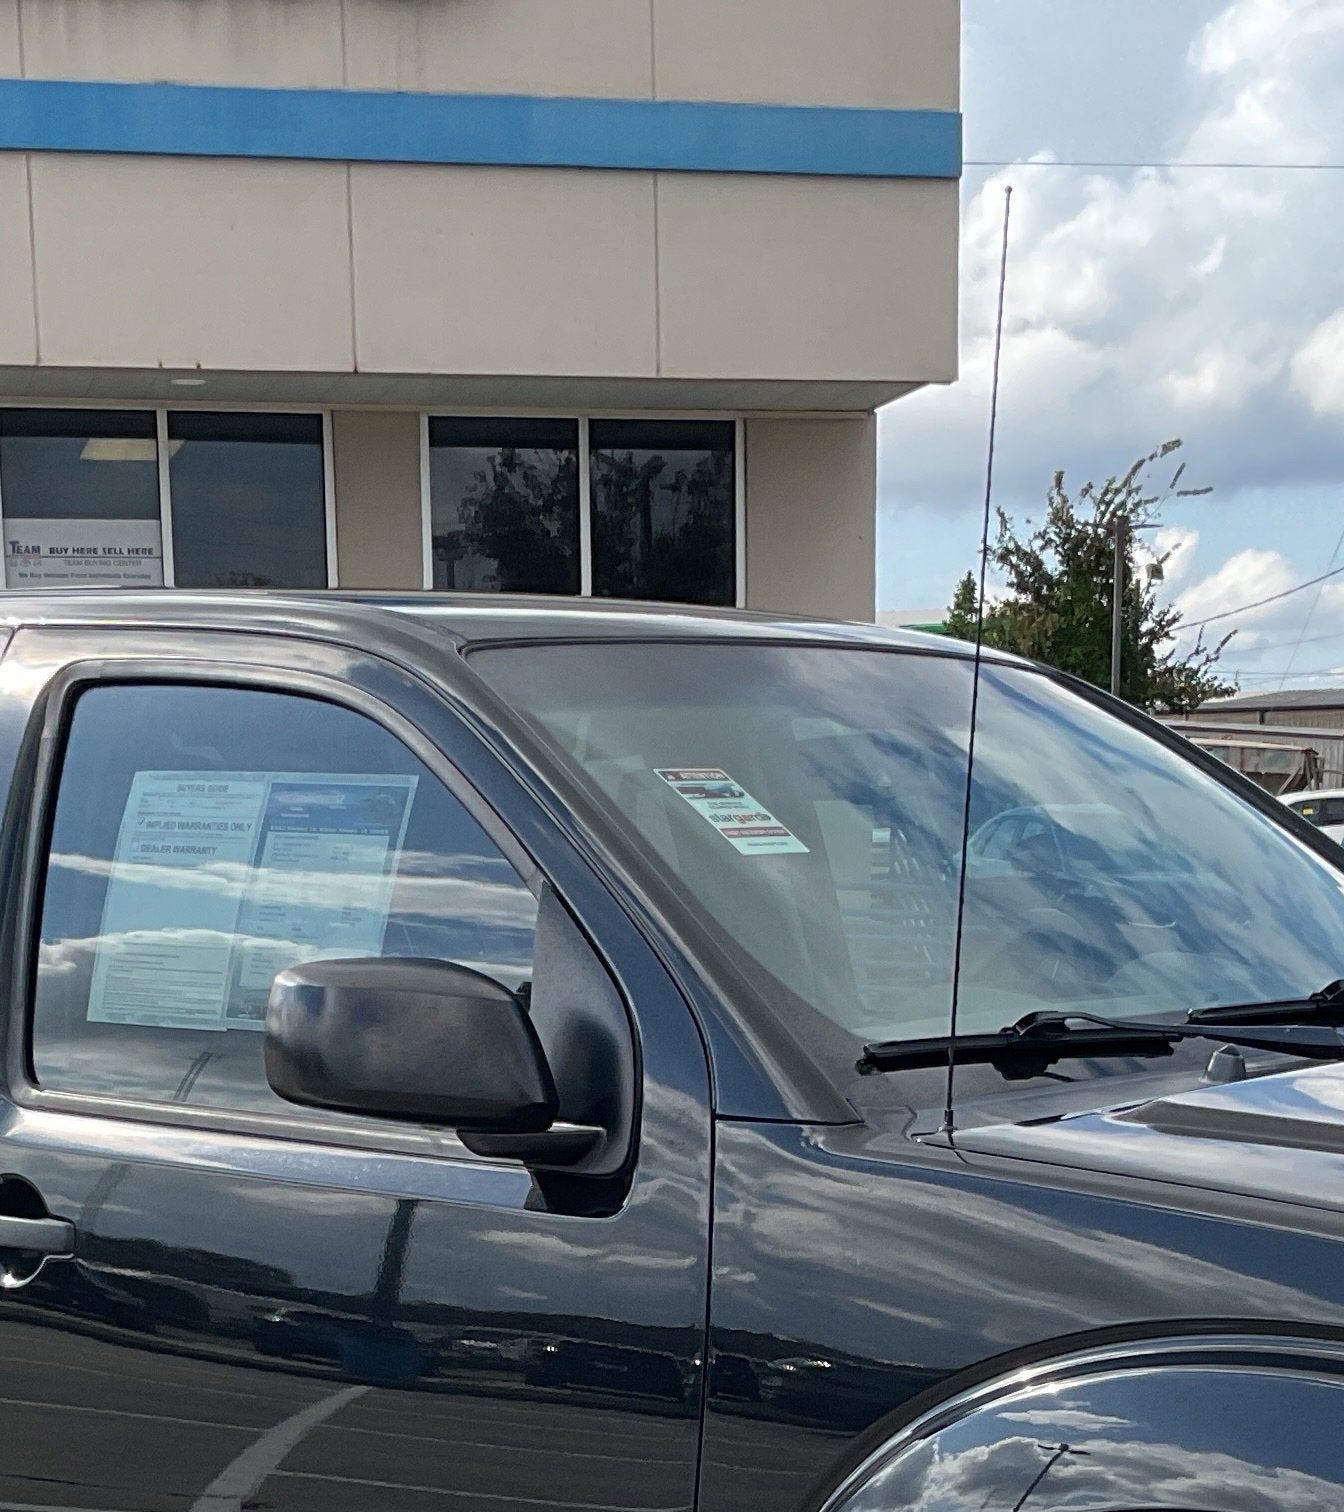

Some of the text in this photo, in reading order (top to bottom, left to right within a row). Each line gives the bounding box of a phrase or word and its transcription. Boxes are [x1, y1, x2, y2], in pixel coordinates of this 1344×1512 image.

[49, 547, 153, 555] BUY HERE SELL HERE
